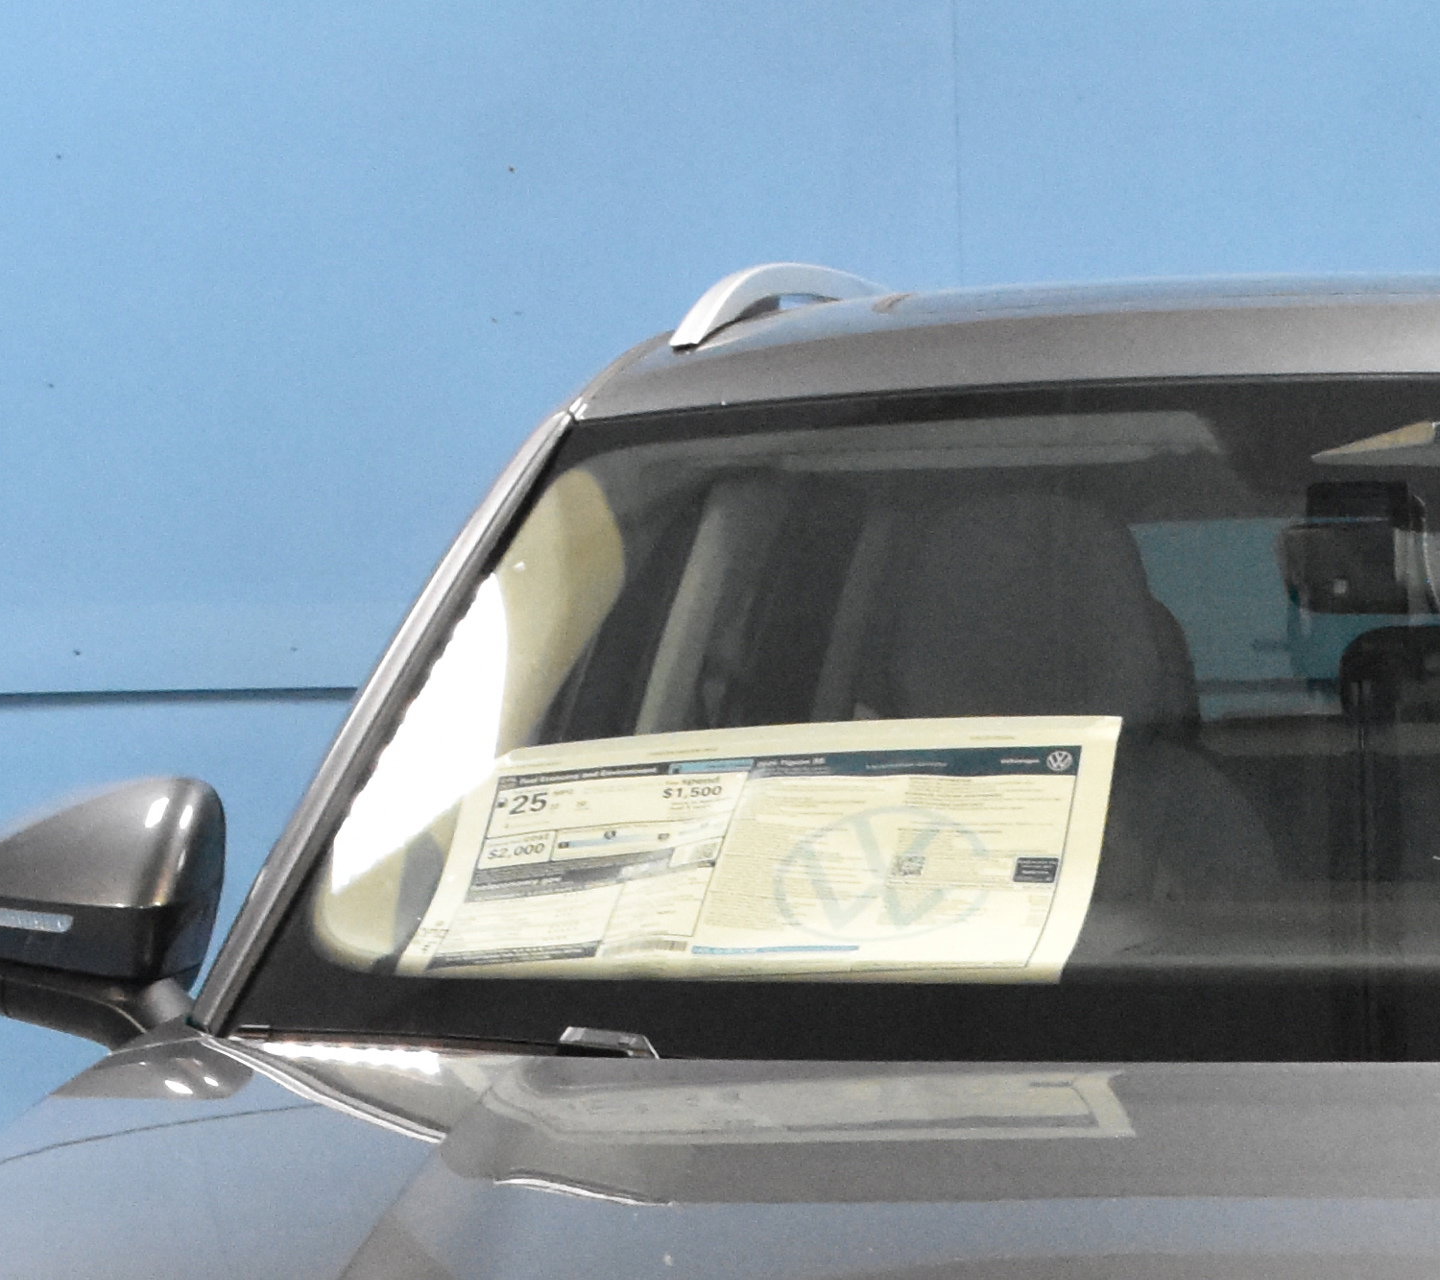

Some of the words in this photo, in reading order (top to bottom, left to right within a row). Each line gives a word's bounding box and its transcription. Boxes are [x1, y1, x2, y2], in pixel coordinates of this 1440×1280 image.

[662, 785, 723, 799] $1,500
[508, 792, 548, 816] 25
[487, 842, 545, 860] $2,000
